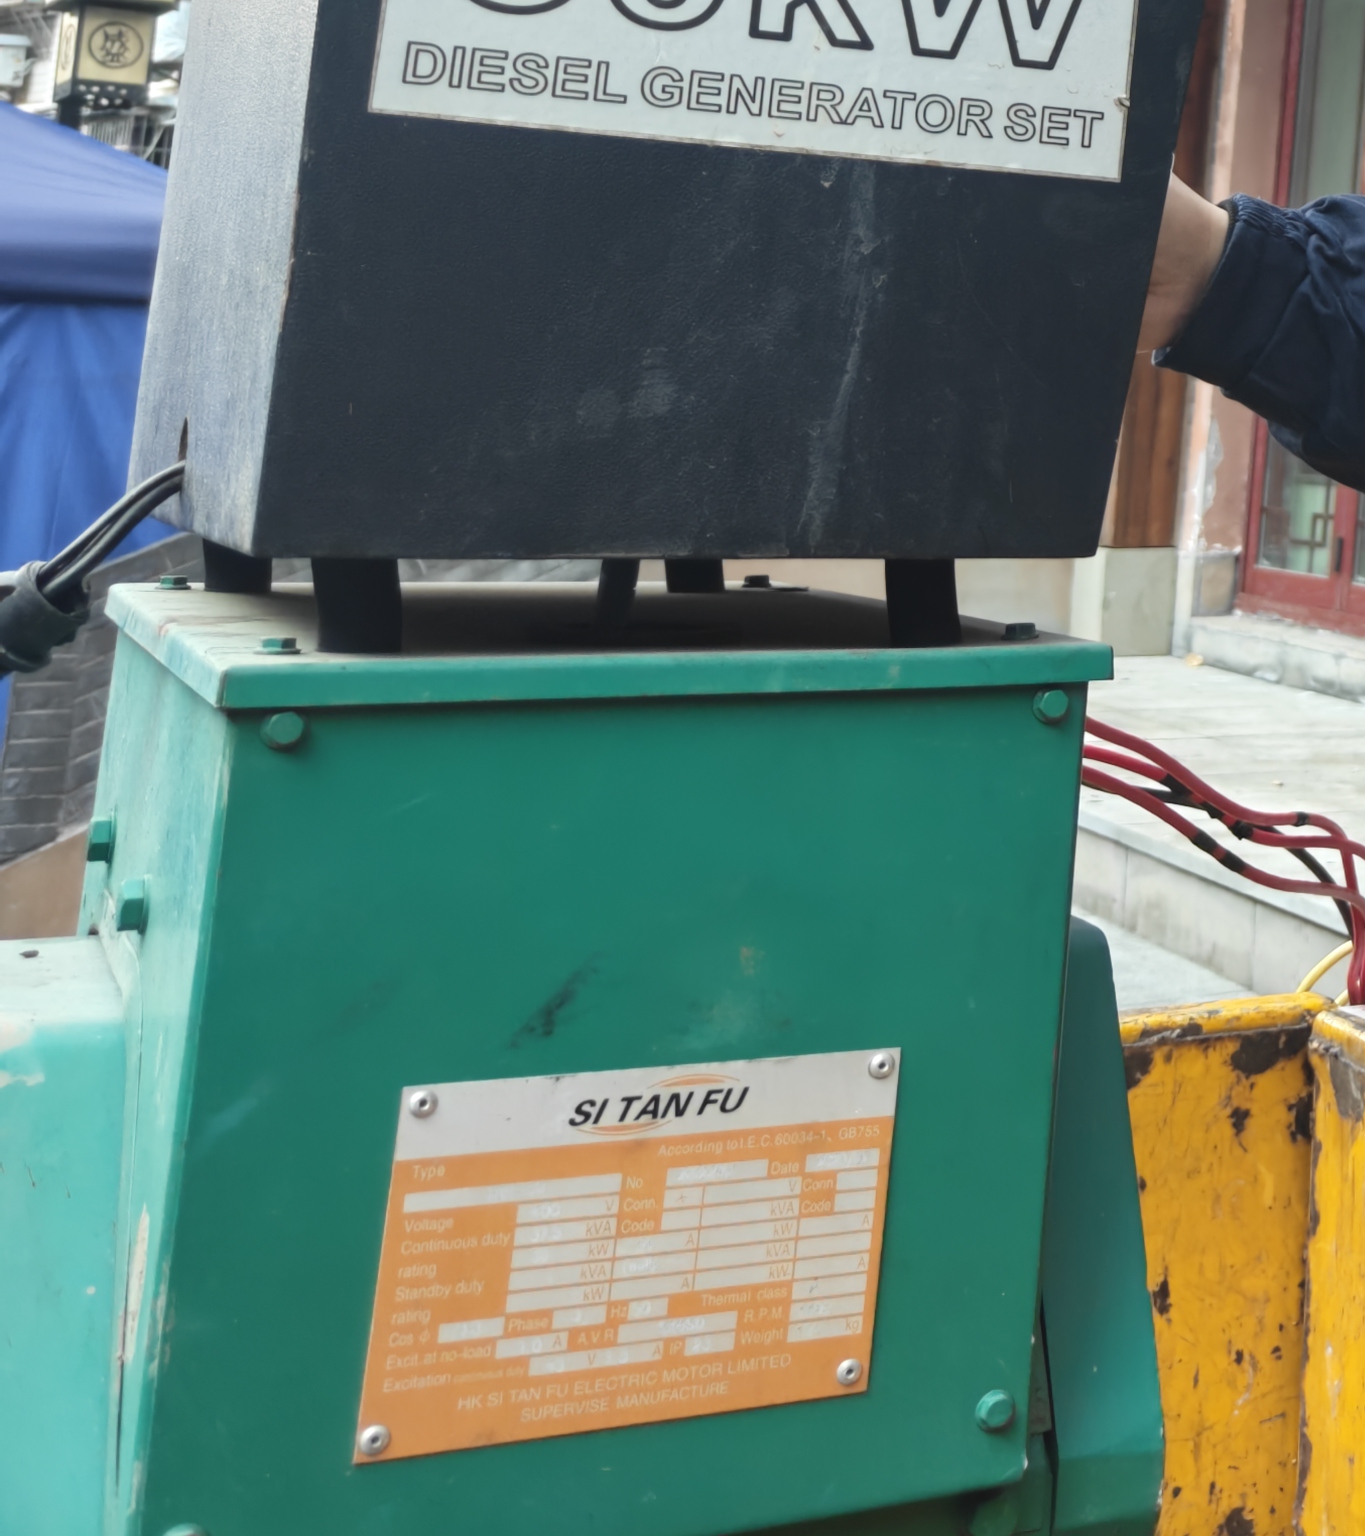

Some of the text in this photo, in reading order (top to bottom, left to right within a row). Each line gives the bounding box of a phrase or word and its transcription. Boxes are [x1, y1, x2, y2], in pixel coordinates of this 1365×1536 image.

[401, 41, 1107, 149] DIESEL GENERATOR SET
[568, 1086, 750, 1127] SI TAN FU
[658, 1137, 723, 1156] According
[838, 1125, 880, 1140] GB755
[412, 1165, 446, 1181] Type
[770, 1161, 799, 1175] Date
[788, 1180, 798, 1193] V
[770, 1201, 796, 1216] kVA
[801, 1198, 831, 1213] Code
[404, 1217, 454, 1234] Voltage
[605, 1199, 614, 1212] V
[862, 1215, 870, 1227] A
[621, 1219, 654, 1234] Code
[773, 1222, 793, 1236] kW
[401, 1235, 478, 1256] Continuous
[481, 1231, 511, 1248] duty
[585, 1220, 612, 1237] kVA
[686, 1234, 695, 1247] A
[588, 1242, 610, 1258] kW
[766, 1243, 791, 1257] kVA
[857, 1257, 866, 1269] A
[398, 1263, 437, 1280] rating
[395, 1282, 451, 1302] Standby
[455, 1279, 485, 1295] duty
[580, 1263, 607, 1279] kVA
[681, 1277, 691, 1291] A
[582, 1286, 604, 1302] kW
[701, 1286, 788, 1307] Thermal class
[391, 1308, 431, 1325] rating
[610, 1304, 628, 1318] Hz
[507, 1316, 549, 1333] Phase
[740, 1328, 784, 1346] Weight
[845, 1316, 860, 1333] kg
[389, 1332, 414, 1347] Cos
[440, 1345, 492, 1364] no-load
[553, 1333, 562, 1347] A
[669, 1342, 682, 1356] IP
[382, 1372, 451, 1393] Excitation
[587, 1353, 596, 1366] V
[652, 1344, 661, 1357] A
[457, 1353, 792, 1411] HK SI TAN FU ELECTRIC MOTOR LIMITED
[519, 1380, 729, 1423] SUPERVISE MANUFACTURE
